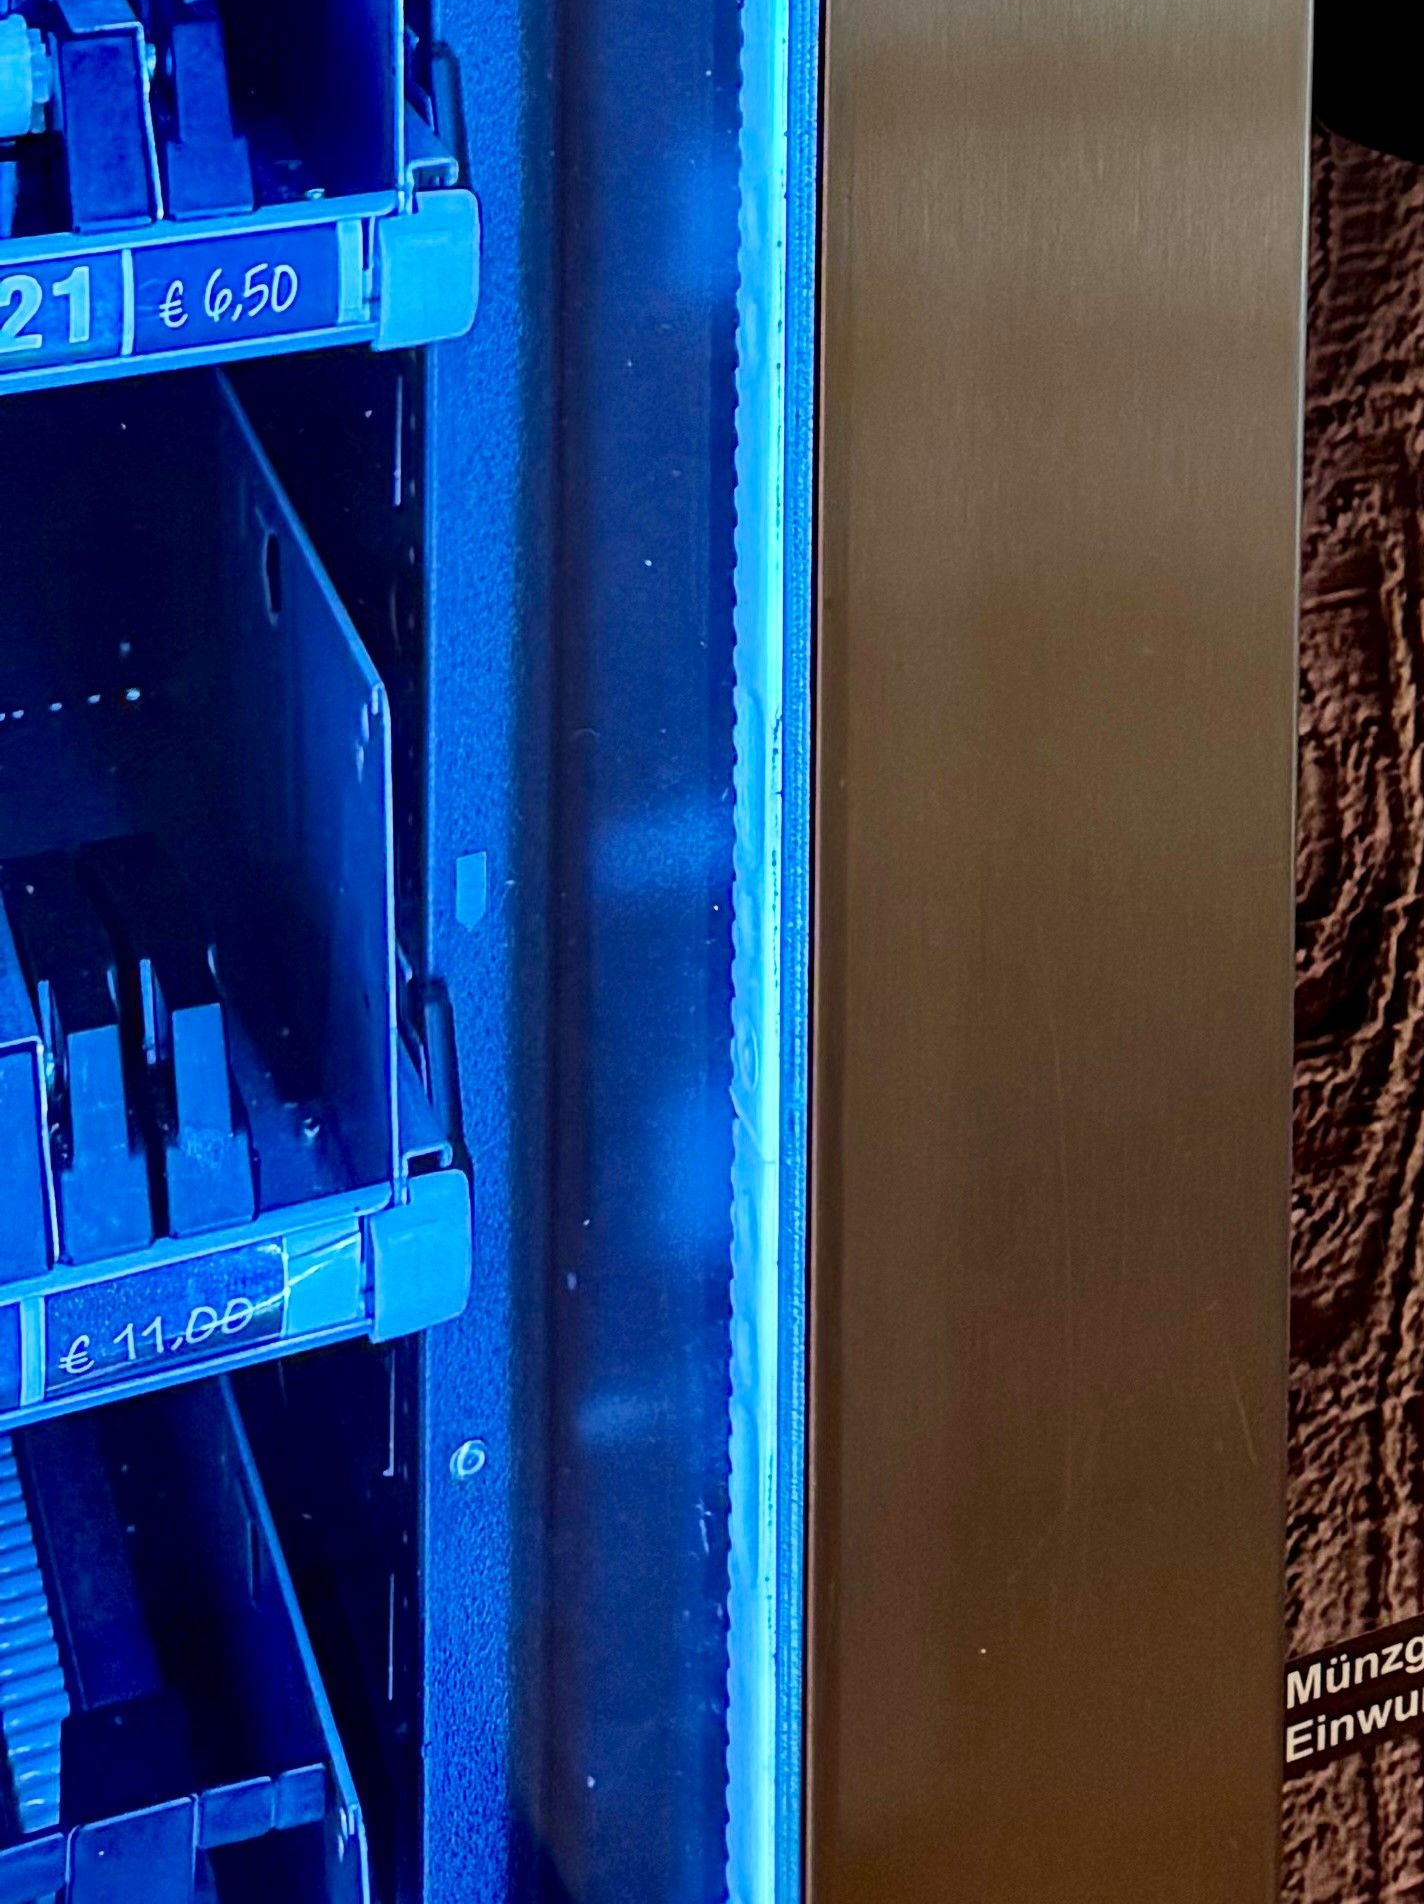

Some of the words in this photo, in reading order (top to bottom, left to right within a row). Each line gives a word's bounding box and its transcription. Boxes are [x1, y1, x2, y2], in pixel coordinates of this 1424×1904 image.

[0, 265, 91, 353] 21
[158, 278, 189, 328] €
[204, 263, 299, 324] 6,50
[58, 1336, 96, 1376] €
[113, 1295, 254, 1362] 11,00
